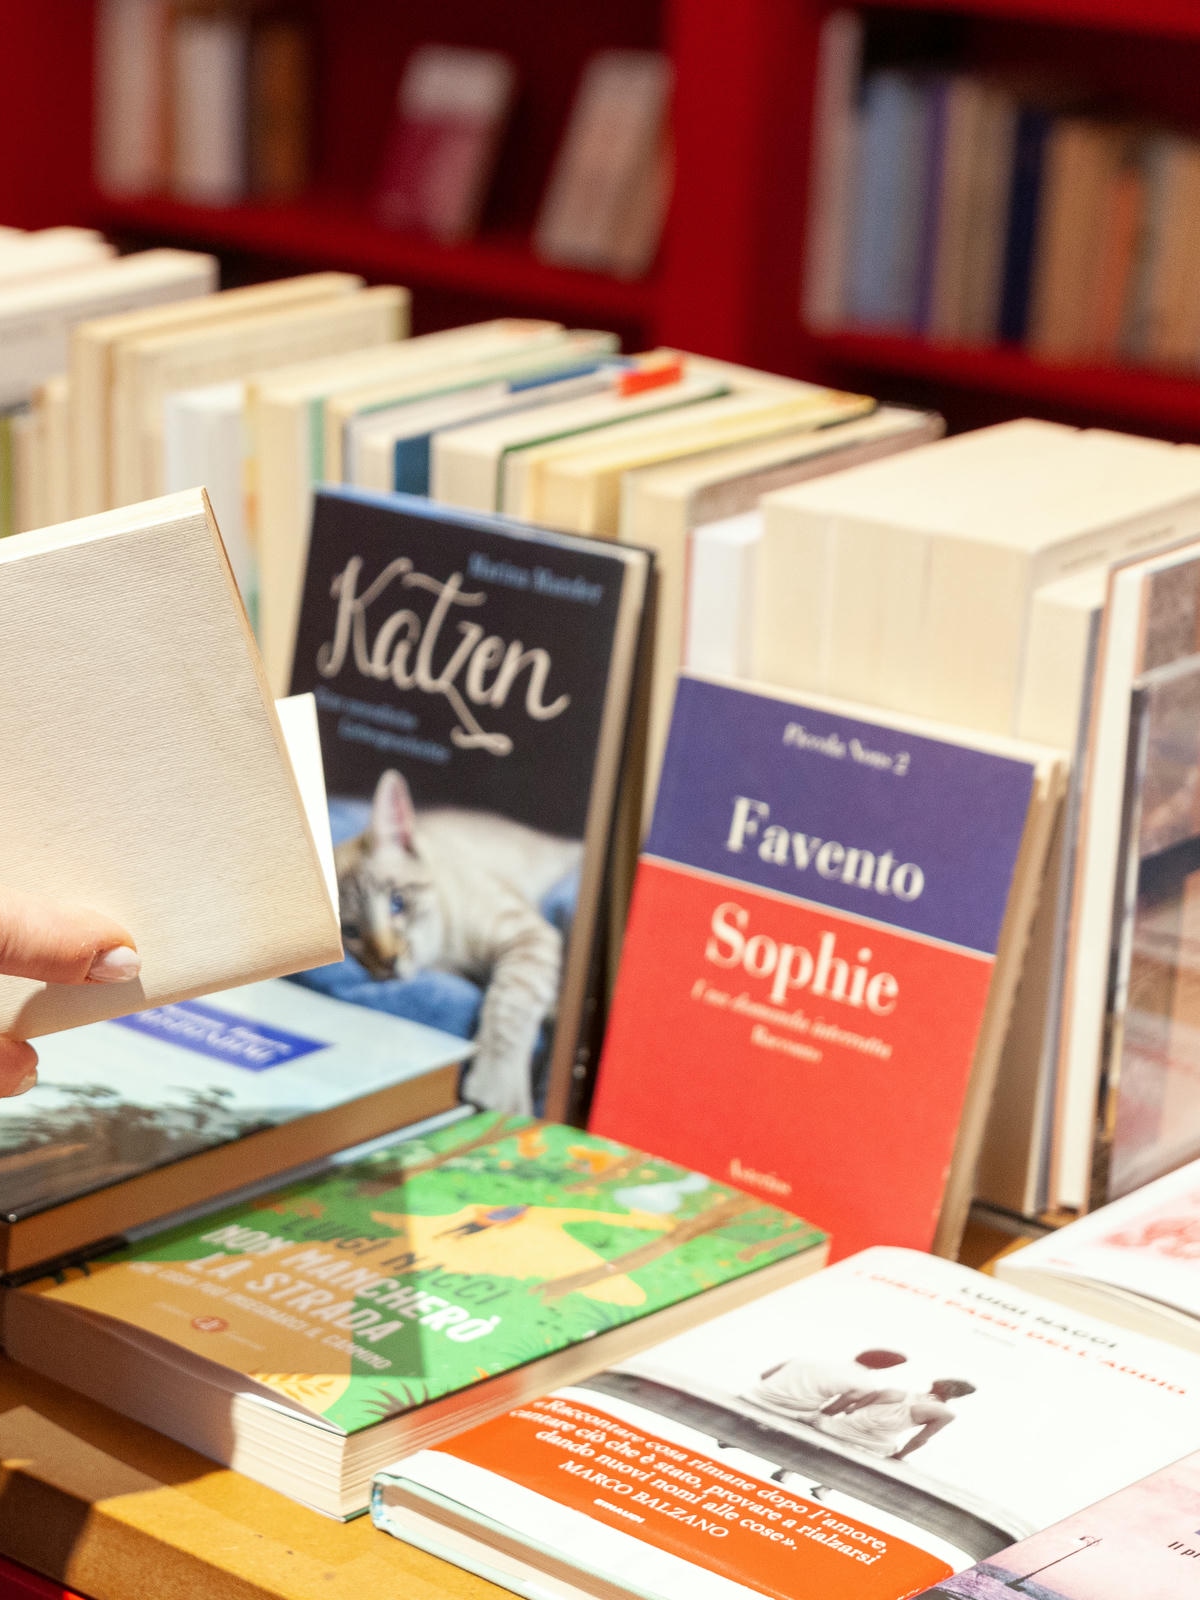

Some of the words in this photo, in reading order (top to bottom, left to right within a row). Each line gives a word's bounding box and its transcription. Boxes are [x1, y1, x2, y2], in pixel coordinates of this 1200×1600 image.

[317, 555, 571, 756] Katzen
[725, 795, 926, 903] Favento
[705, 901, 899, 1016] Sophie
[186, 1252, 253, 1280] LA
[245, 1272, 404, 1342] STRADA
[200, 1224, 295, 1258] NON
[281, 1247, 502, 1343] MANCHERÒ
[279, 1217, 391, 1256] LUIGI
[380, 1252, 513, 1306] NACCI
[321, 1334, 393, 1370] CAMMINO
[944, 1299, 1019, 1331] PASSI
[960, 1286, 1029, 1316] LUIGI
[1035, 1316, 1118, 1349] NACCI
[509, 1409, 577, 1433] cantare
[575, 1427, 606, 1443] ciò
[605, 1439, 640, 1458] che
[639, 1453, 656, 1465] è
[653, 1461, 702, 1489] stato,
[702, 1484, 783, 1521] provare
[782, 1516, 798, 1529] a
[796, 1523, 882, 1566] rialzarsi
[535, 1430, 595, 1458] dando
[595, 1454, 657, 1482] nuovi
[650, 1478, 708, 1505] nomi
[702, 1498, 740, 1521] alle
[558, 1459, 634, 1495] MARCO
[631, 1491, 730, 1538] BALZANO
[593, 1497, 646, 1523] EINAUDI
[645, 1441, 689, 1462] cosa
[688, 1457, 757, 1492] rimane
[757, 1488, 809, 1515] dopo
